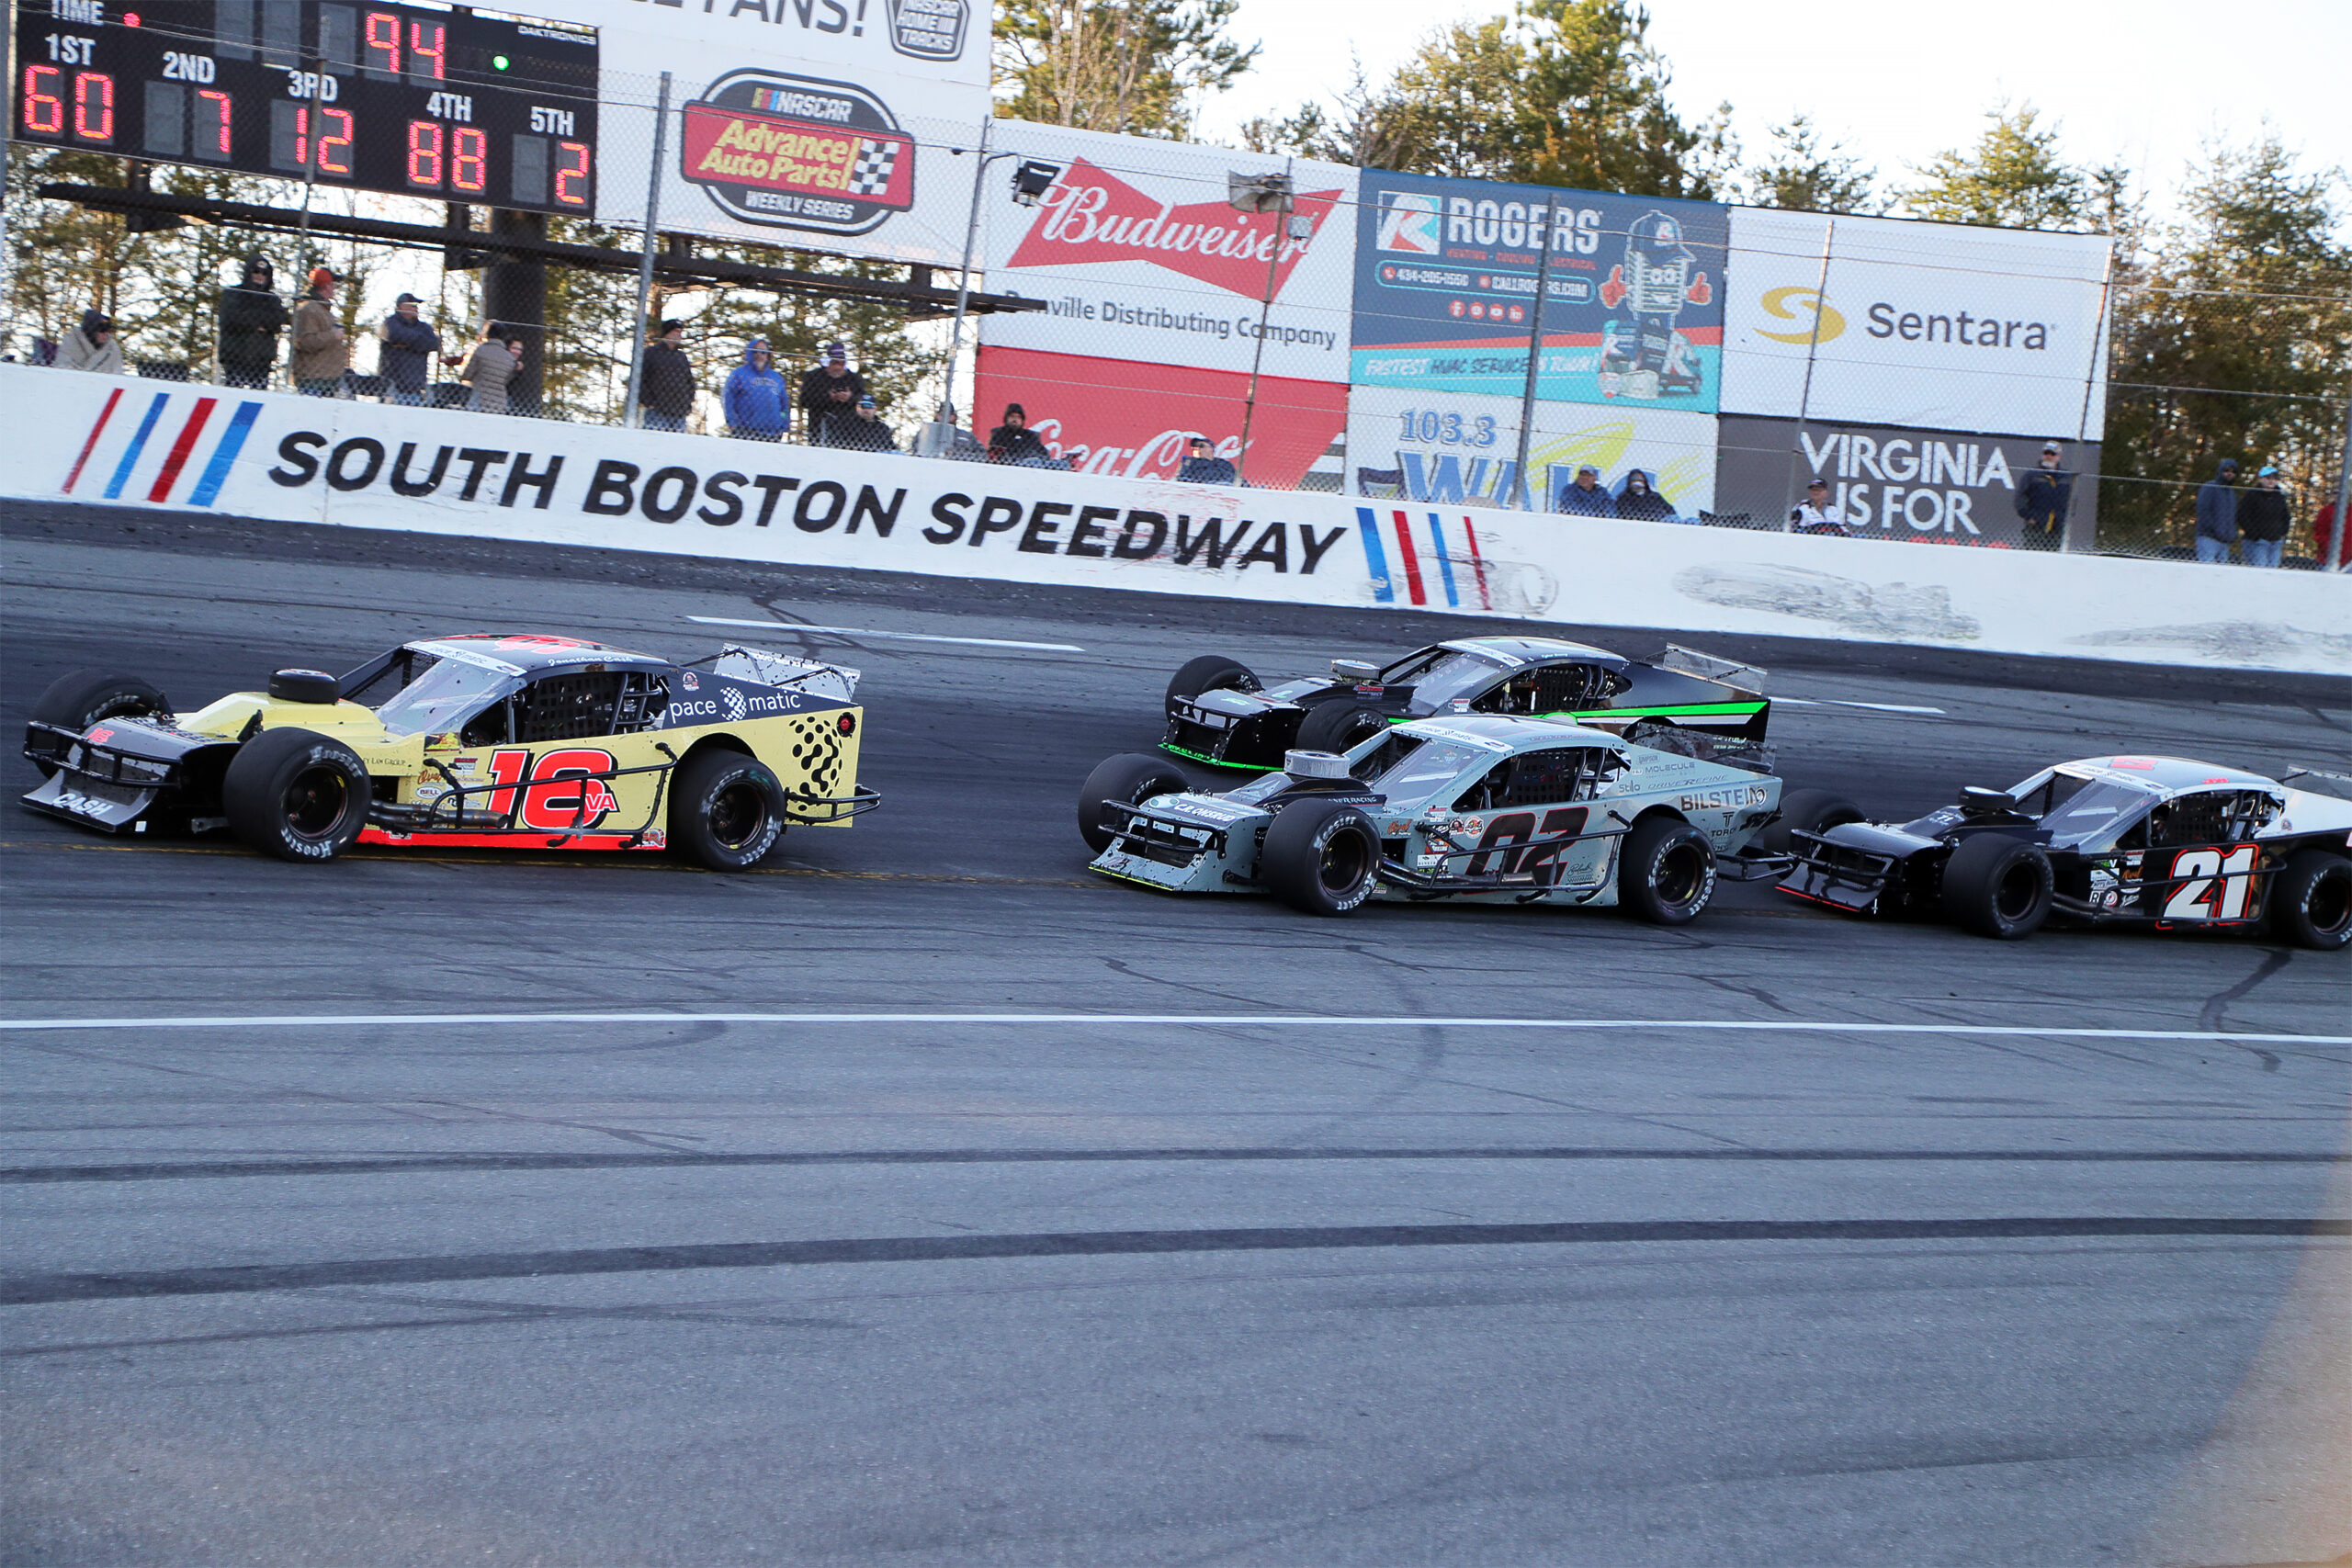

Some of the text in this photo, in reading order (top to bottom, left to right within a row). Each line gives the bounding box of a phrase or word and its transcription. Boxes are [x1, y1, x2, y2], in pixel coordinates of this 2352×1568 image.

[45, 32, 96, 66] 1ST
[366, 11, 446, 81] 94
[518, 25, 597, 47] DAKTRONICS
[162, 51, 216, 85] 2ND
[288, 70, 338, 103] 3RD
[24, 64, 114, 140] 60
[198, 89, 231, 153] 7
[425, 91, 472, 122] 4TH
[530, 106, 574, 137] 5TH
[775, 92, 853, 122] NASCAR
[296, 107, 354, 173] 12
[407, 120, 487, 190] 88
[714, 119, 848, 164] Advance
[556, 141, 589, 204] 2
[697, 148, 842, 189] Auto Parts
[745, 190, 854, 220] WEEKLY SERIES
[1038, 184, 1310, 264] Budweiser
[1448, 197, 1600, 254] ROGERS
[1102, 300, 1229, 340] Distributing
[1238, 318, 1336, 350] Company
[1866, 301, 2047, 351] Sentara
[1364, 358, 1430, 376] FASTEST
[1399, 409, 1497, 449] 103.3
[1800, 432, 2015, 490] VIRGINIA
[269, 430, 1348, 576] SOUTH BOSTON SPEEDWAY
[1836, 481, 1981, 535] IS FOR
[669, 692, 801, 724] pace matic
[1645, 761, 1695, 773] MOLECULE
[52, 793, 114, 817] CASH
[419, 788, 440, 796] BELL
[486, 749, 618, 830] 16
[584, 792, 619, 813] VA
[1679, 786, 1759, 811] BILSTEIN
[1462, 807, 1589, 895] 02
[2159, 844, 2257, 922] 21
